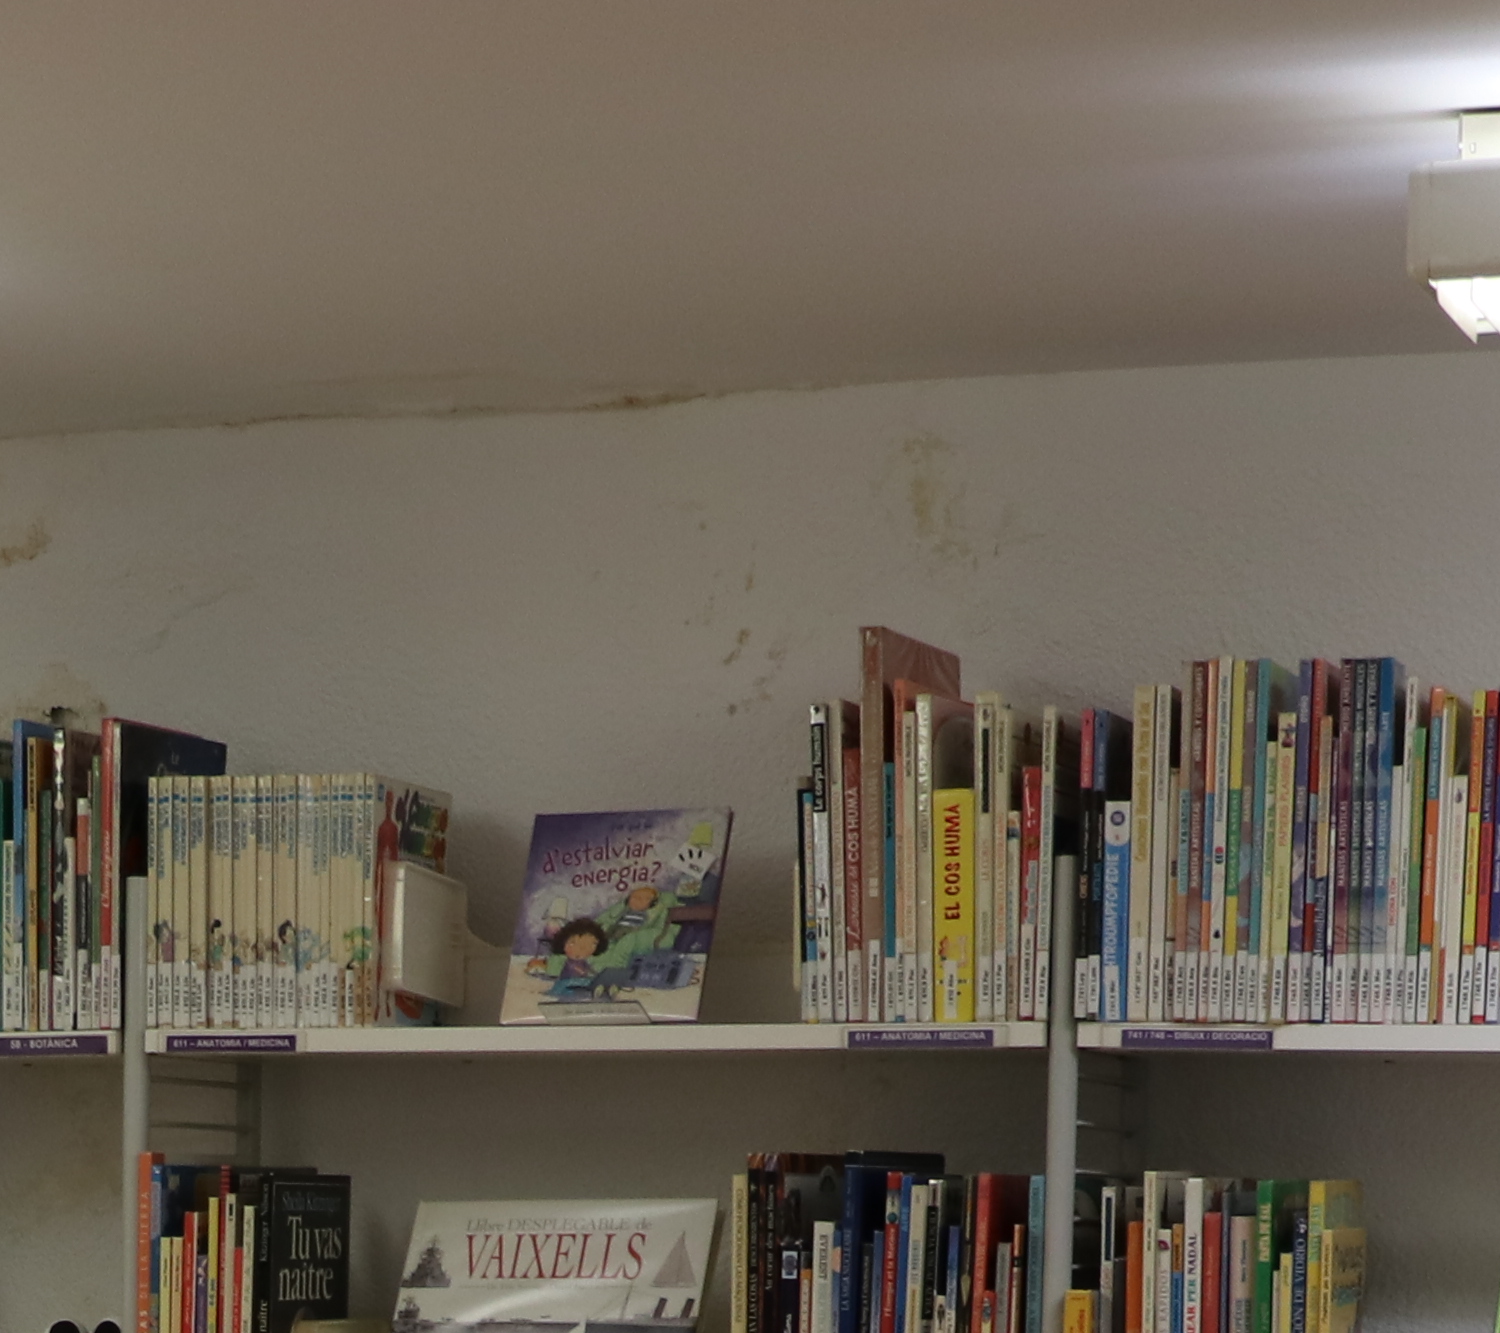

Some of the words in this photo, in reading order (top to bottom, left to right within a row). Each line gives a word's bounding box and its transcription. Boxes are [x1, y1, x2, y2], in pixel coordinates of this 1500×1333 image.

[543, 836, 655, 876] d'estalviar
[571, 861, 662, 892] energia?
[945, 863, 961, 896] COS
[945, 903, 961, 921] EL
[196, 1038, 242, 1048] ANATOMIA
[247, 1038, 290, 1048] MEDICINA
[880, 1031, 928, 1041] ANATOMIA
[938, 1031, 986, 1041] MEDICINA
[287, 1215, 312, 1260] Tu
[313, 1227, 342, 1260] vas
[465, 1231, 647, 1281] VAIXELLS
[1187, 1232, 1198, 1276] NADAL
[1293, 1238, 1306, 1282] VIDRIO
[279, 1262, 335, 1301] naître
